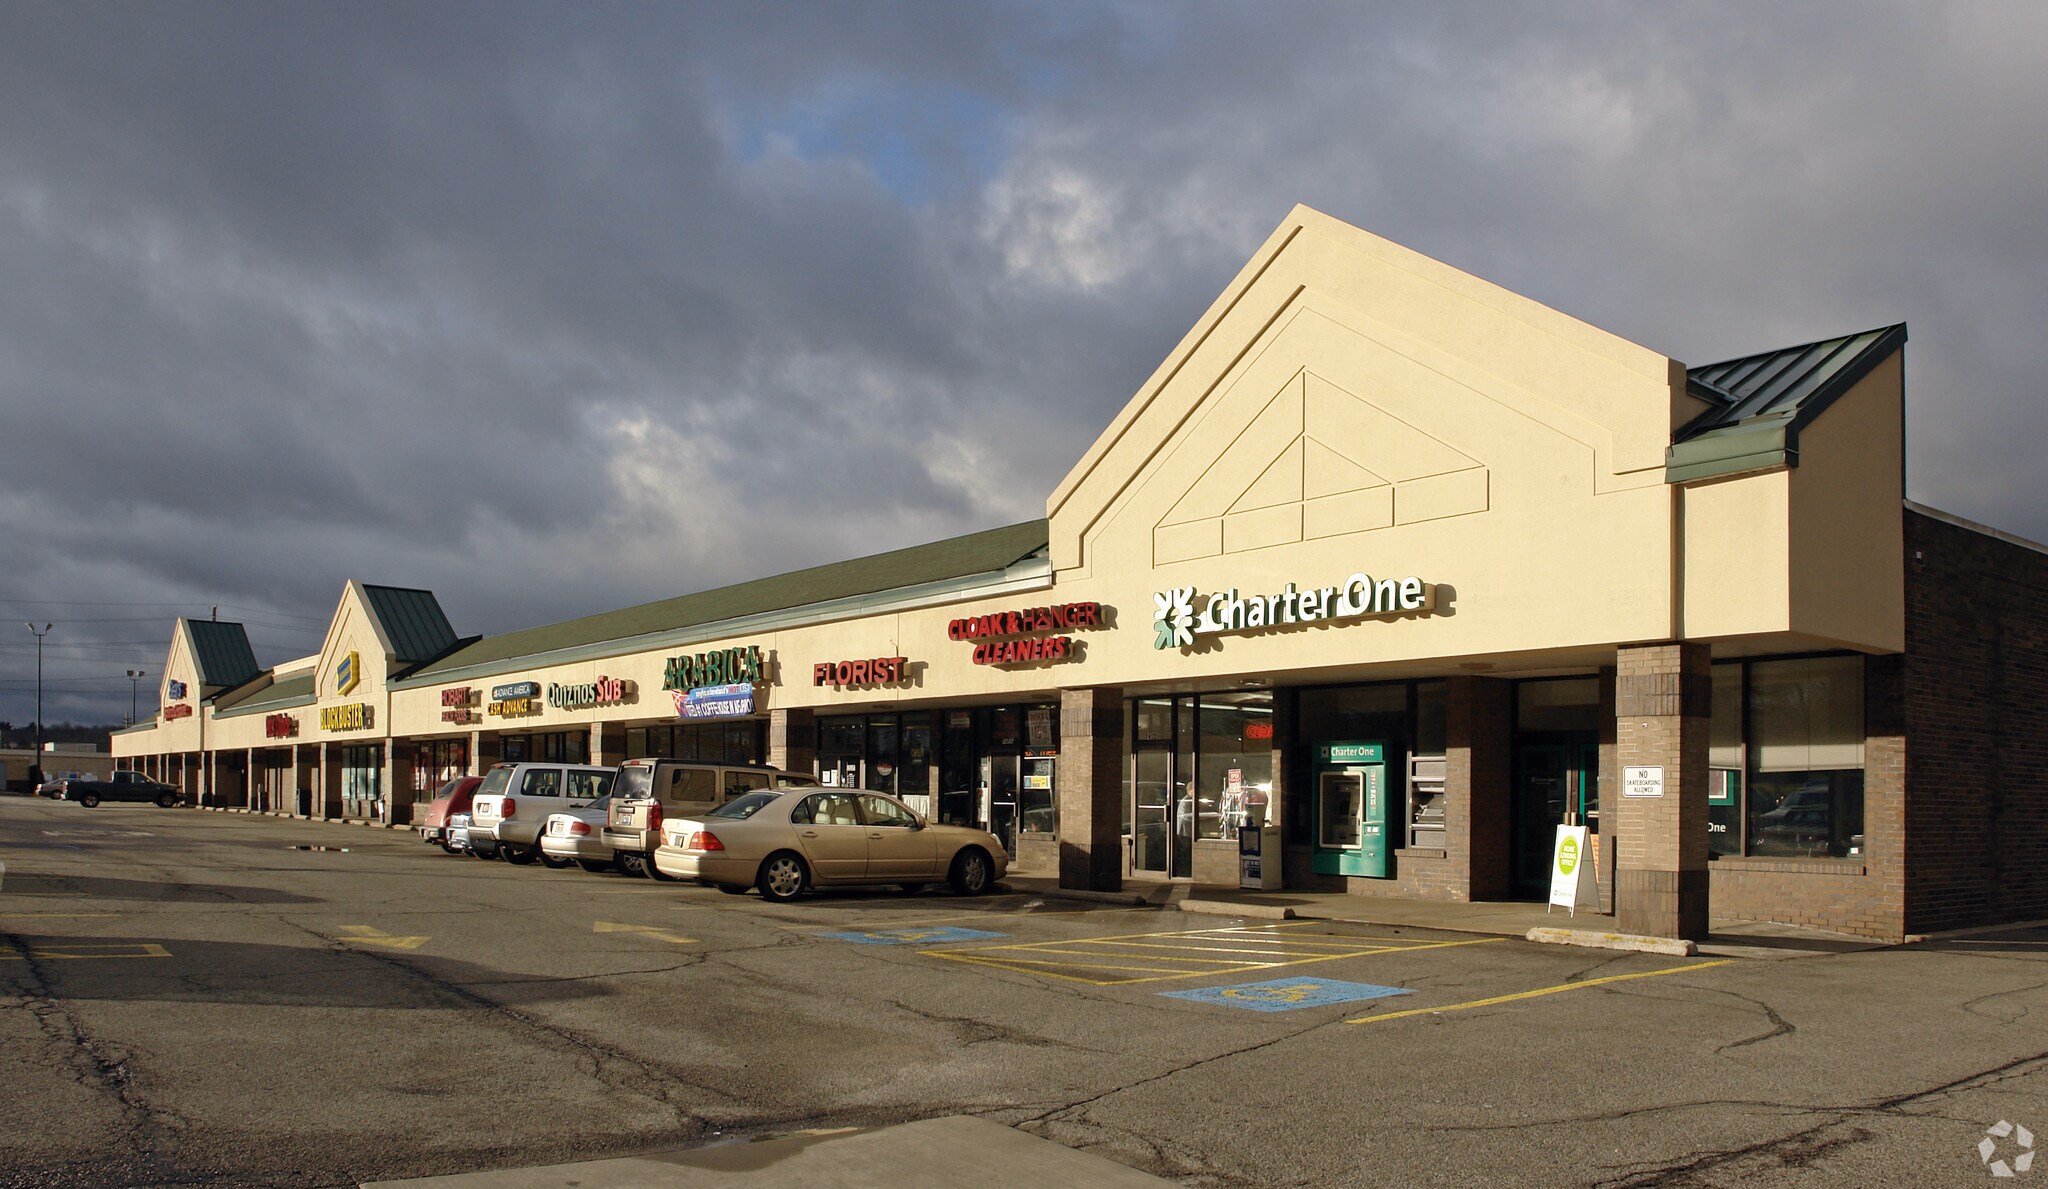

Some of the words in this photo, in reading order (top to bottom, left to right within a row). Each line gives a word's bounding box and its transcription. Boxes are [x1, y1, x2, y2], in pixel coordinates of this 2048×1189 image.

[1205, 582, 1337, 632] Charter
[1342, 572, 1425, 616] One
[949, 612, 1002, 640] CLOAK
[1006, 611, 1019, 632] &
[972, 636, 1066, 665] CLEANERS
[662, 645, 760, 691] ARABICA
[814, 657, 903, 686] FLORIST
[441, 687, 467, 706] HOBART
[488, 702, 500, 716] CASH
[503, 698, 527, 714] ADVANCE
[320, 703, 362, 730] BLOCKBUSTER
[1331, 747, 1357, 757] Charter
[1358, 746, 1375, 756] One
[1638, 770, 1648, 779] NO
